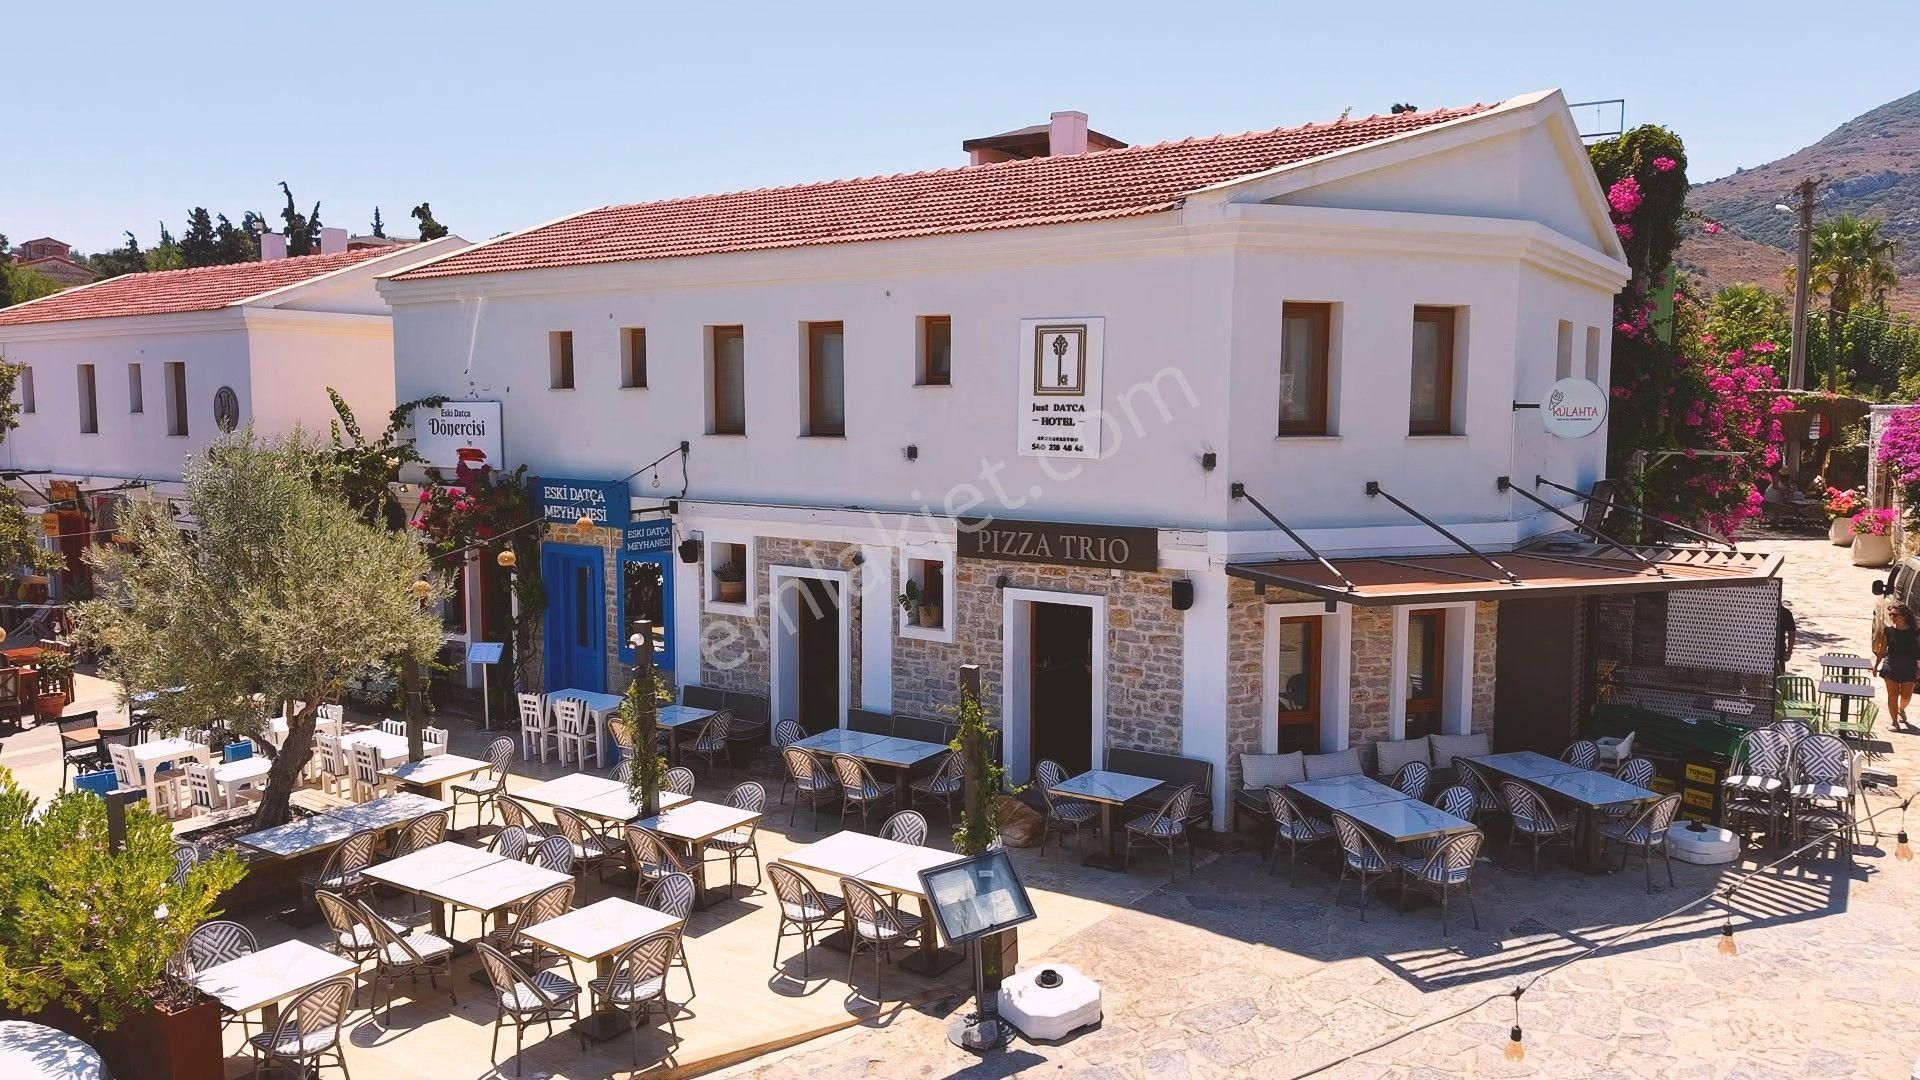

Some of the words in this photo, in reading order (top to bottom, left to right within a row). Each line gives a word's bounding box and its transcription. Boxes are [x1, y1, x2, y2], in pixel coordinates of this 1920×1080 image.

[440, 408, 454, 418] Eski
[454, 409, 471, 420] Datça
[1032, 403, 1048, 412] Just
[1053, 403, 1085, 412] DATCA
[1552, 405, 1599, 417] KÜLAHTA
[428, 417, 486, 438] Dönercisi
[1041, 417, 1075, 426] HOTEL
[543, 485, 568, 500] ESKİ
[569, 487, 606, 507] DATÇA
[543, 504, 608, 523] MEYHANESİ
[627, 527, 645, 539] ESKİ
[645, 526, 671, 539] DATÇA
[977, 529, 1054, 559] PIZZA
[1059, 534, 1131, 565] TRIO
